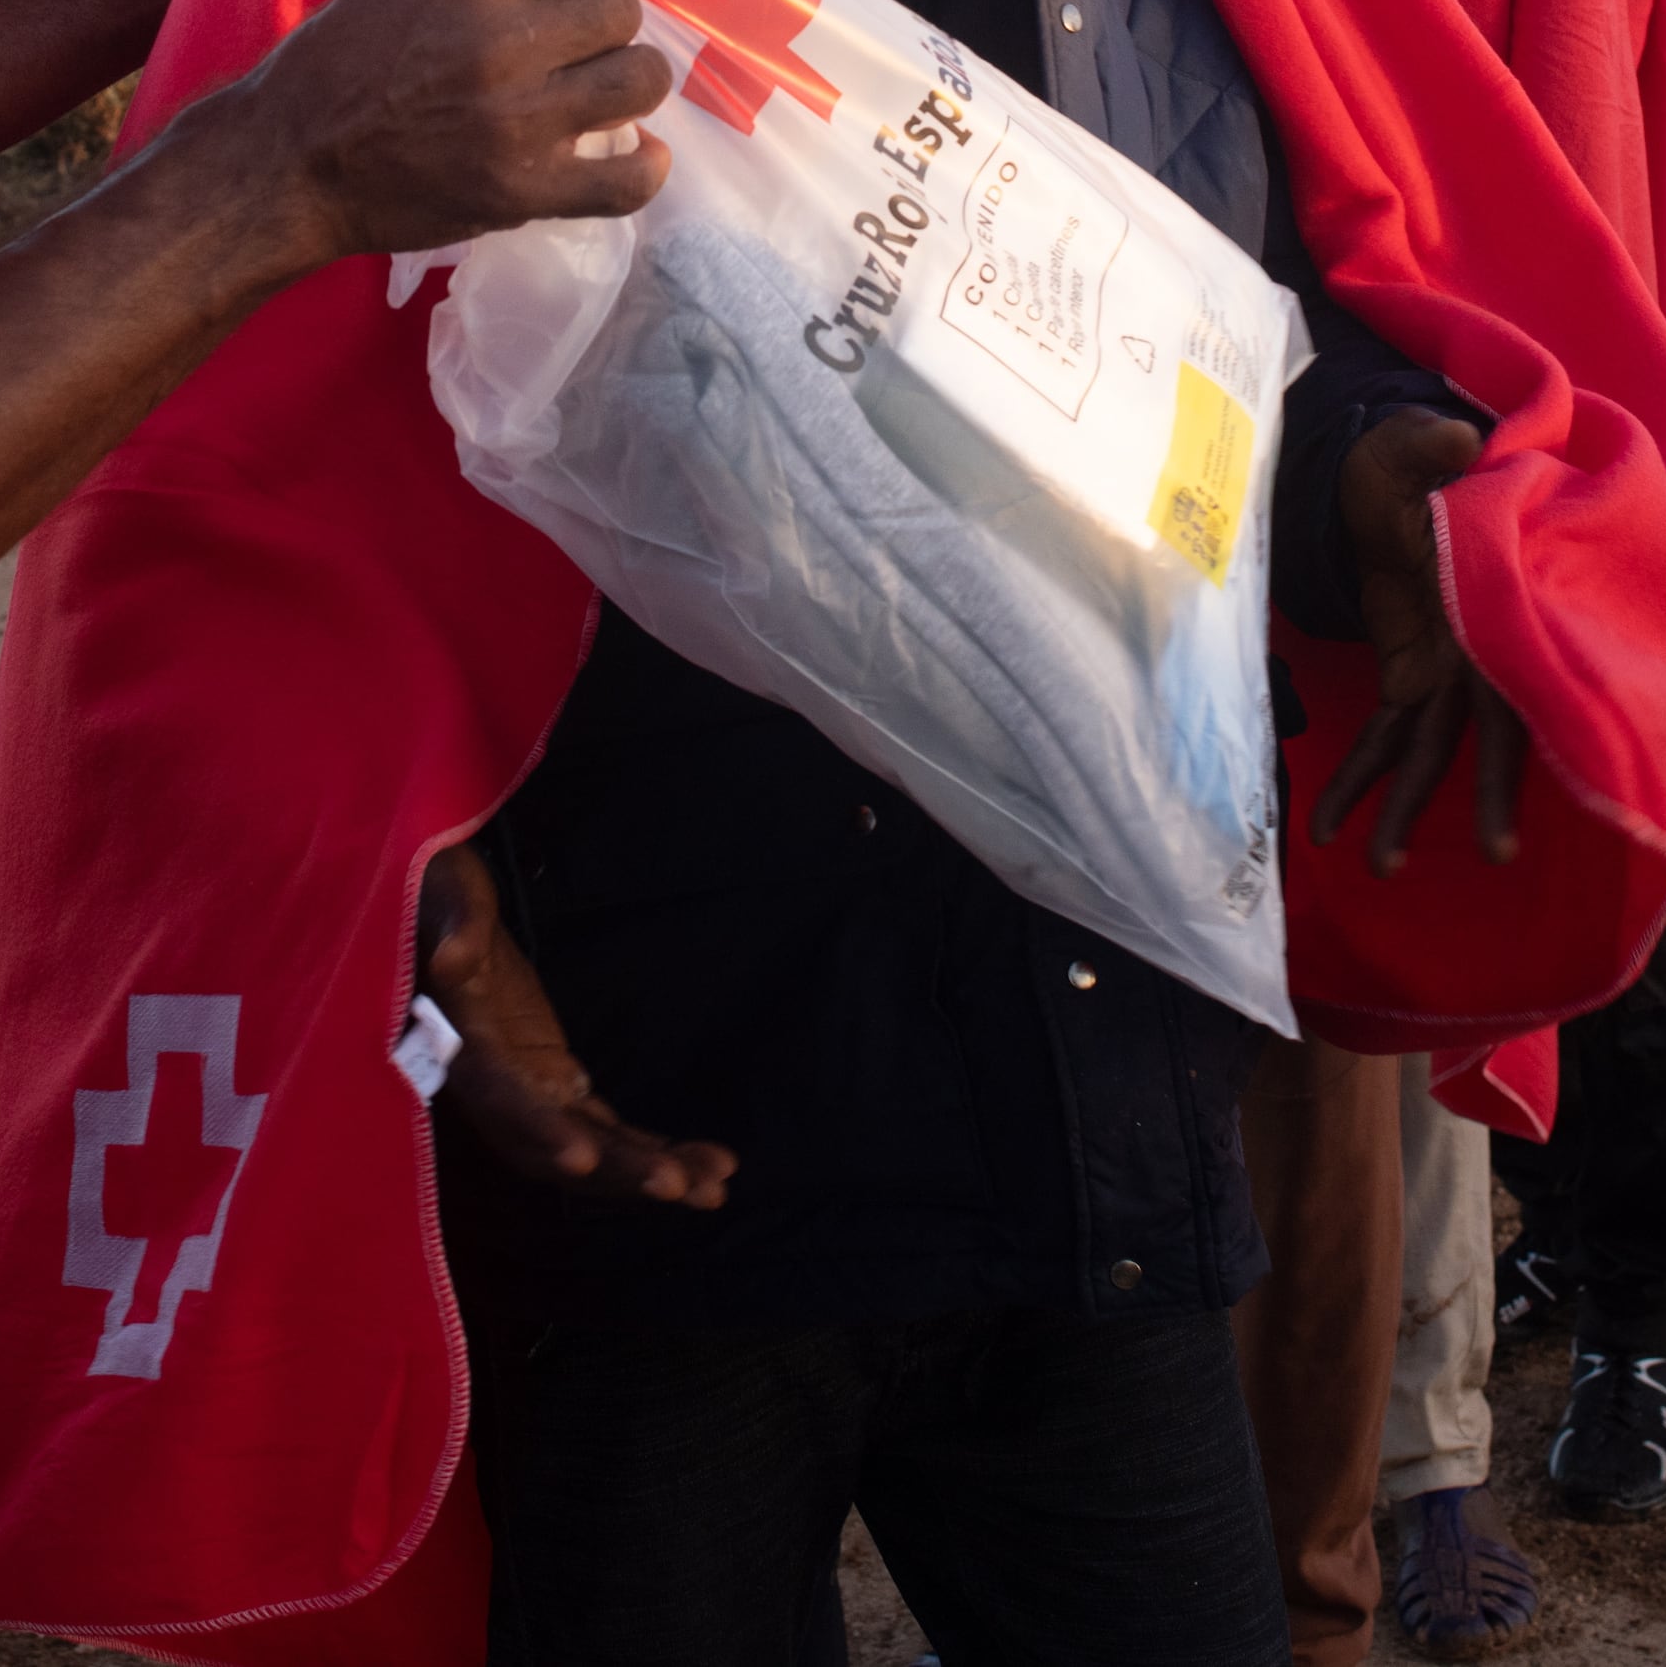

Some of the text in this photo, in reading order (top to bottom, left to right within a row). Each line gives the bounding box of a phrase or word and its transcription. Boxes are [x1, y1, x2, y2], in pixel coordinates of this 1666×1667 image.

[803, 252, 903, 374] Cruz
[991, 308, 1009, 323] 1
[1015, 324, 1032, 339] 1
[1038, 340, 1055, 354] 1
[1061, 355, 1077, 368] 1
